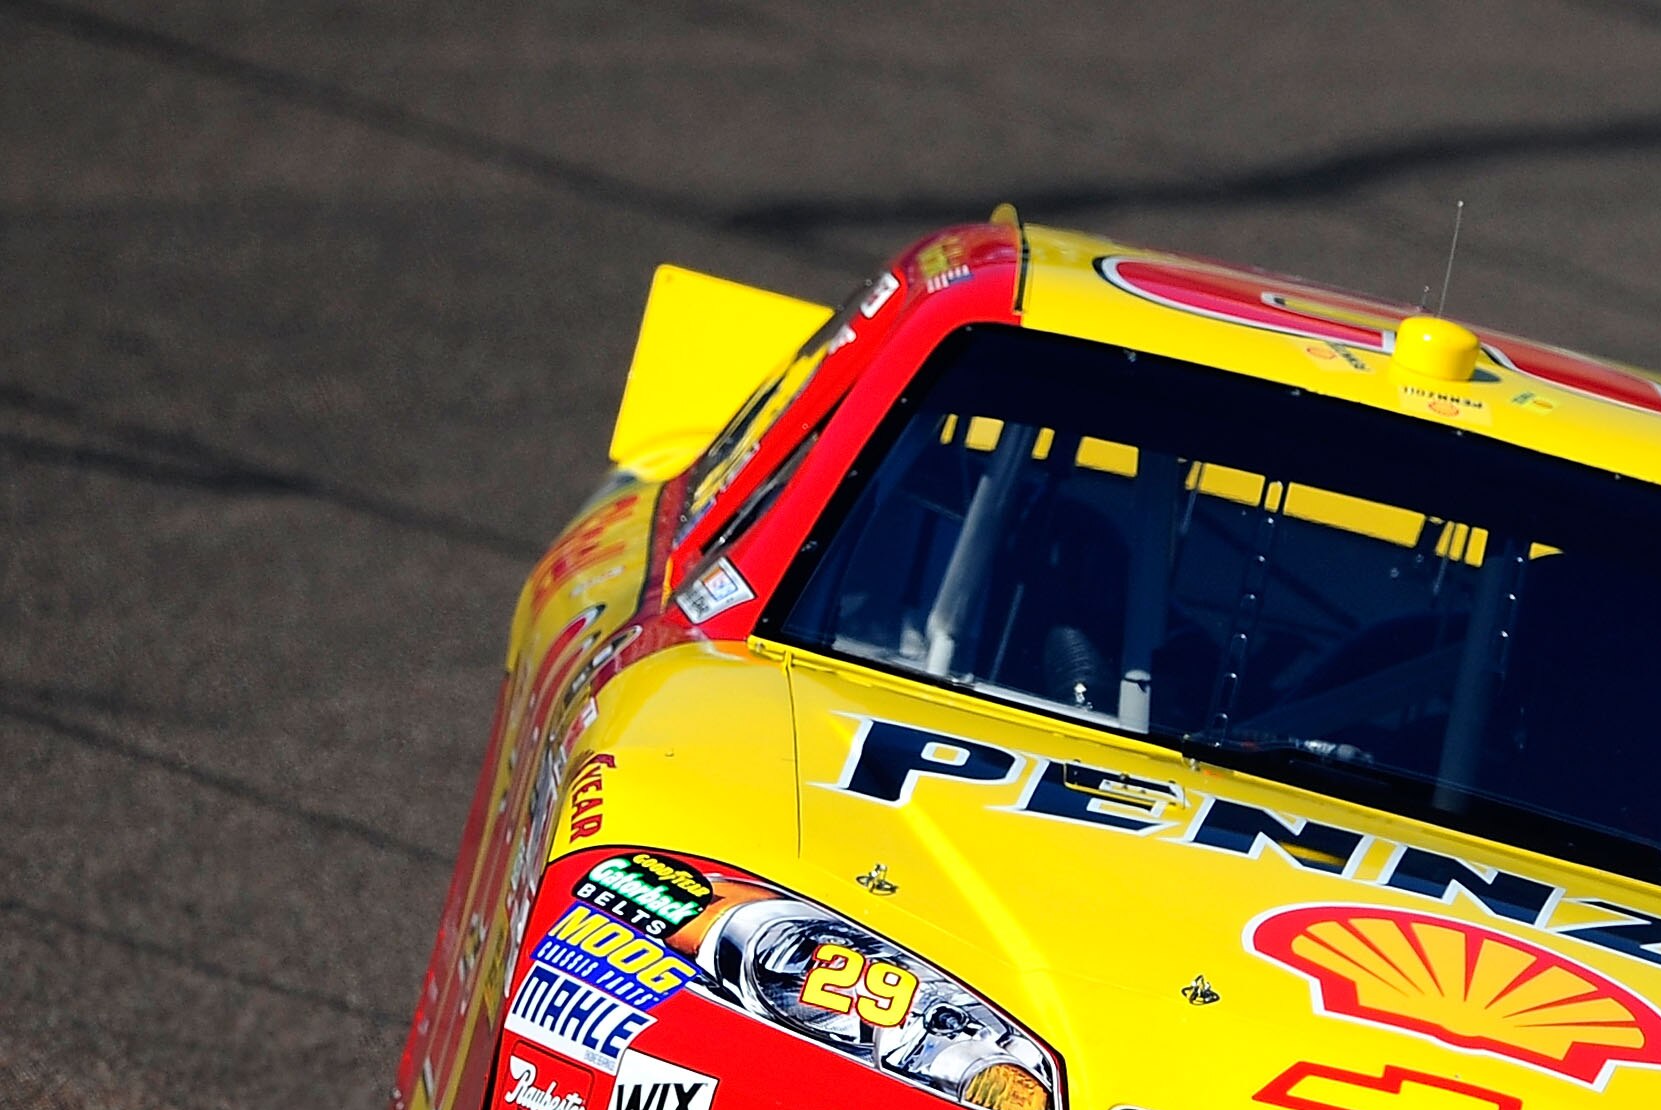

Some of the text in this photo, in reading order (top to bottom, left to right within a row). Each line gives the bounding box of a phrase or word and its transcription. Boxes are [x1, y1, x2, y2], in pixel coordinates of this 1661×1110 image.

[577, 883, 664, 936] BELTS
[589, 857, 700, 926] Gatorback
[632, 854, 711, 898] GOODYEAR
[537, 941, 658, 1007] CHASSIS PARTS
[549, 907, 696, 993] MOOG
[513, 973, 648, 1059] MAHLE
[798, 942, 919, 1028] 29
